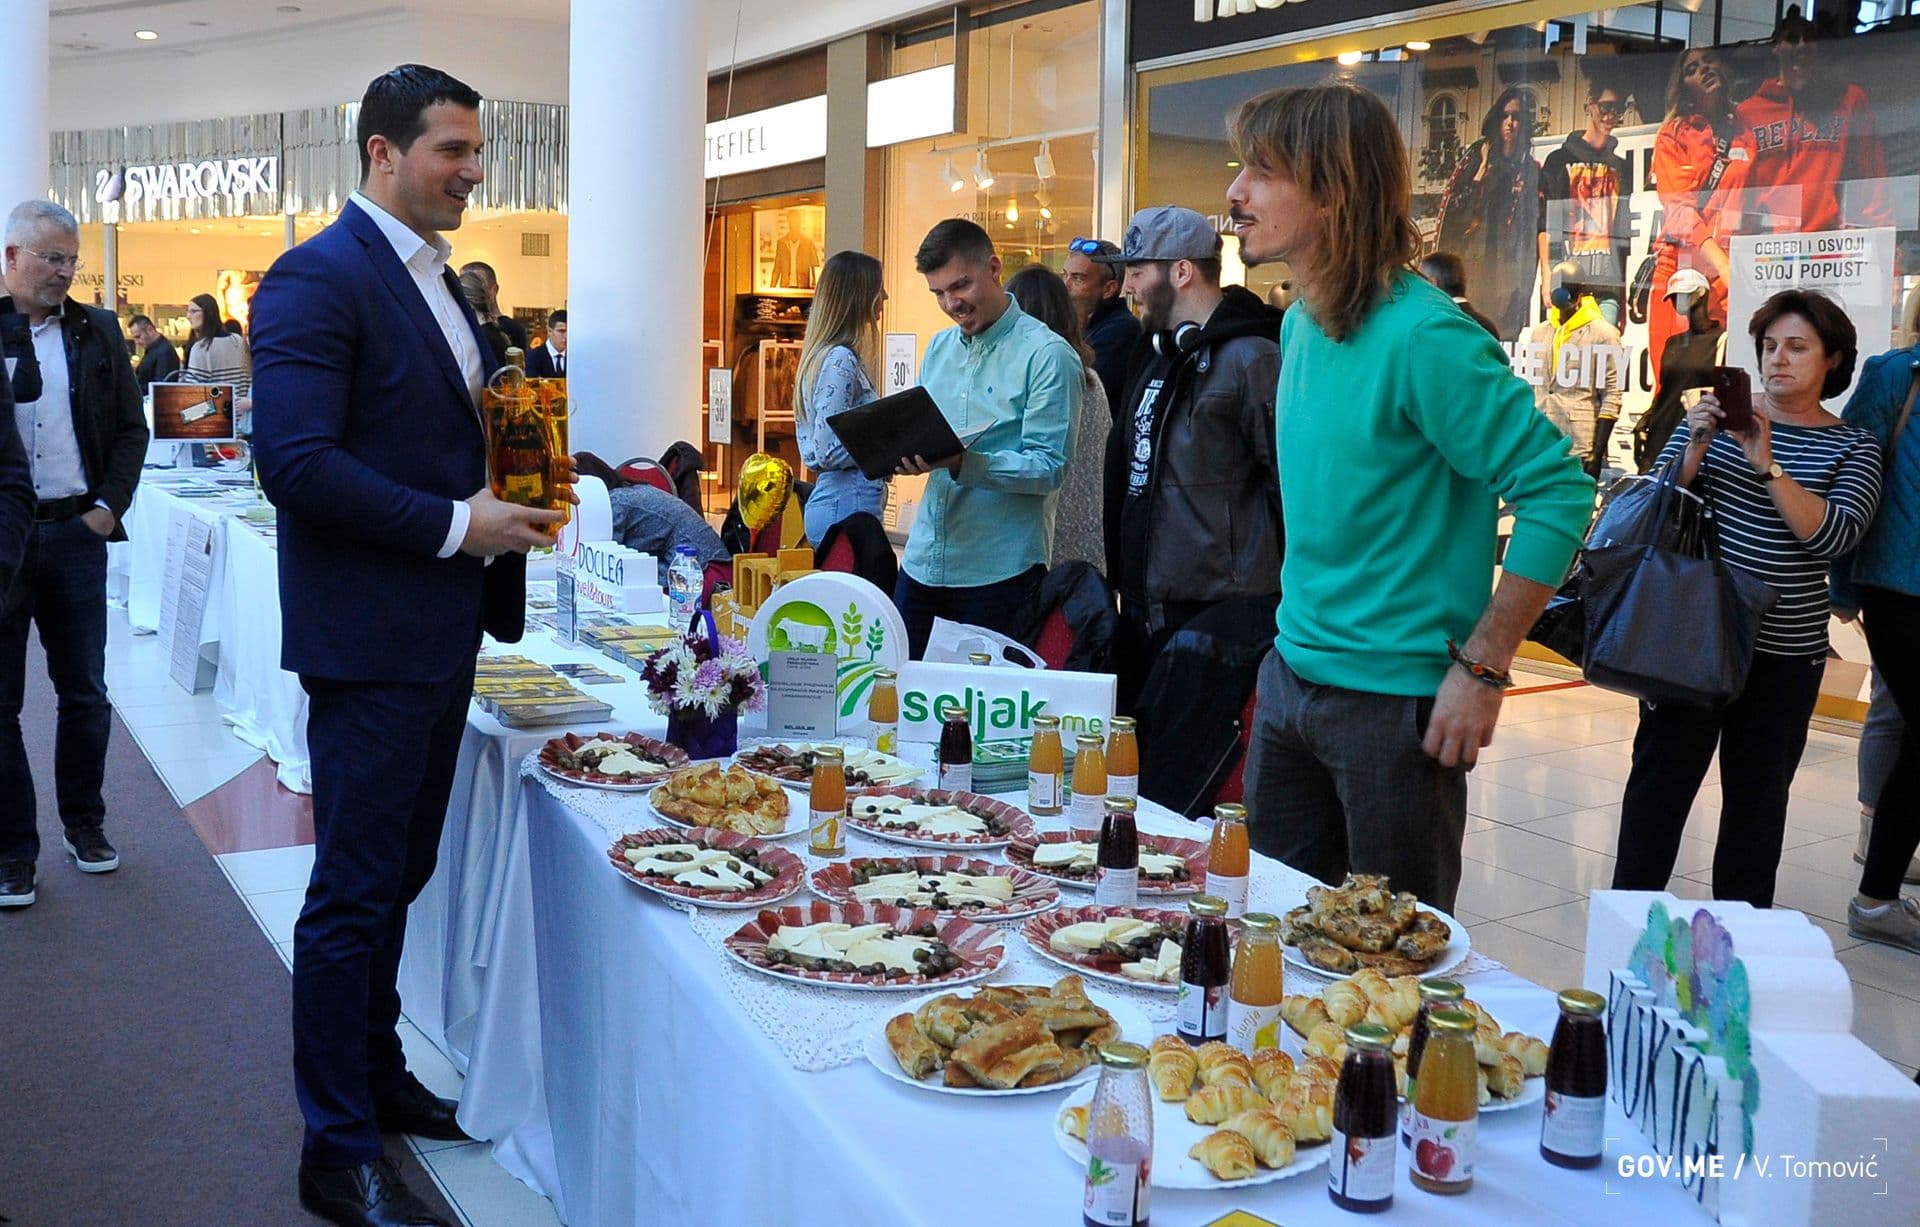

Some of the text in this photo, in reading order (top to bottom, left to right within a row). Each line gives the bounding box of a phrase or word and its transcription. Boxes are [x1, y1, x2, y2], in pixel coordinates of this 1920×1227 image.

[124, 156, 278, 202] SWAROVSKI
[1755, 240, 1802, 255] OGREBI
[1808, 239, 1812, 253] I
[1755, 264, 1793, 281] SVOJ
[1556, 343, 1632, 390] CITY
[903, 688, 1048, 742] seljak
[1231, 1010, 1261, 1039] dunja
